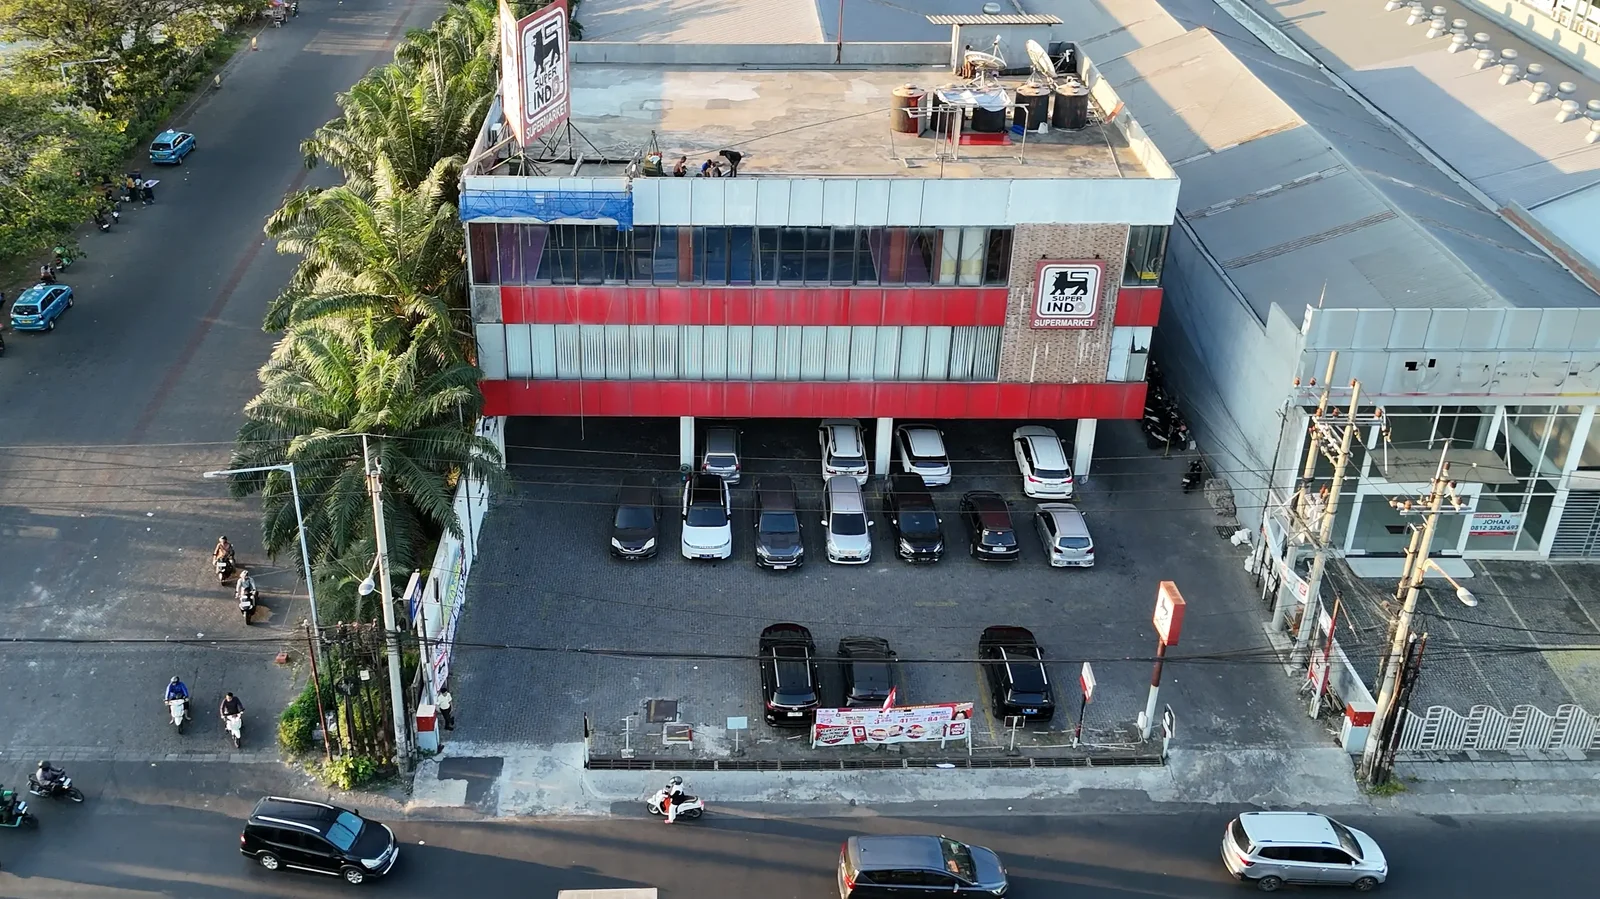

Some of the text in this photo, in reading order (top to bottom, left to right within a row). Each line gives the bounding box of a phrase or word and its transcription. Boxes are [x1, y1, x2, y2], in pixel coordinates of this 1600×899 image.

[535, 67, 557, 89] SUPER
[533, 75, 560, 110] INDO
[525, 101, 568, 140] SUPERMARKET
[1047, 302, 1086, 312] INDO
